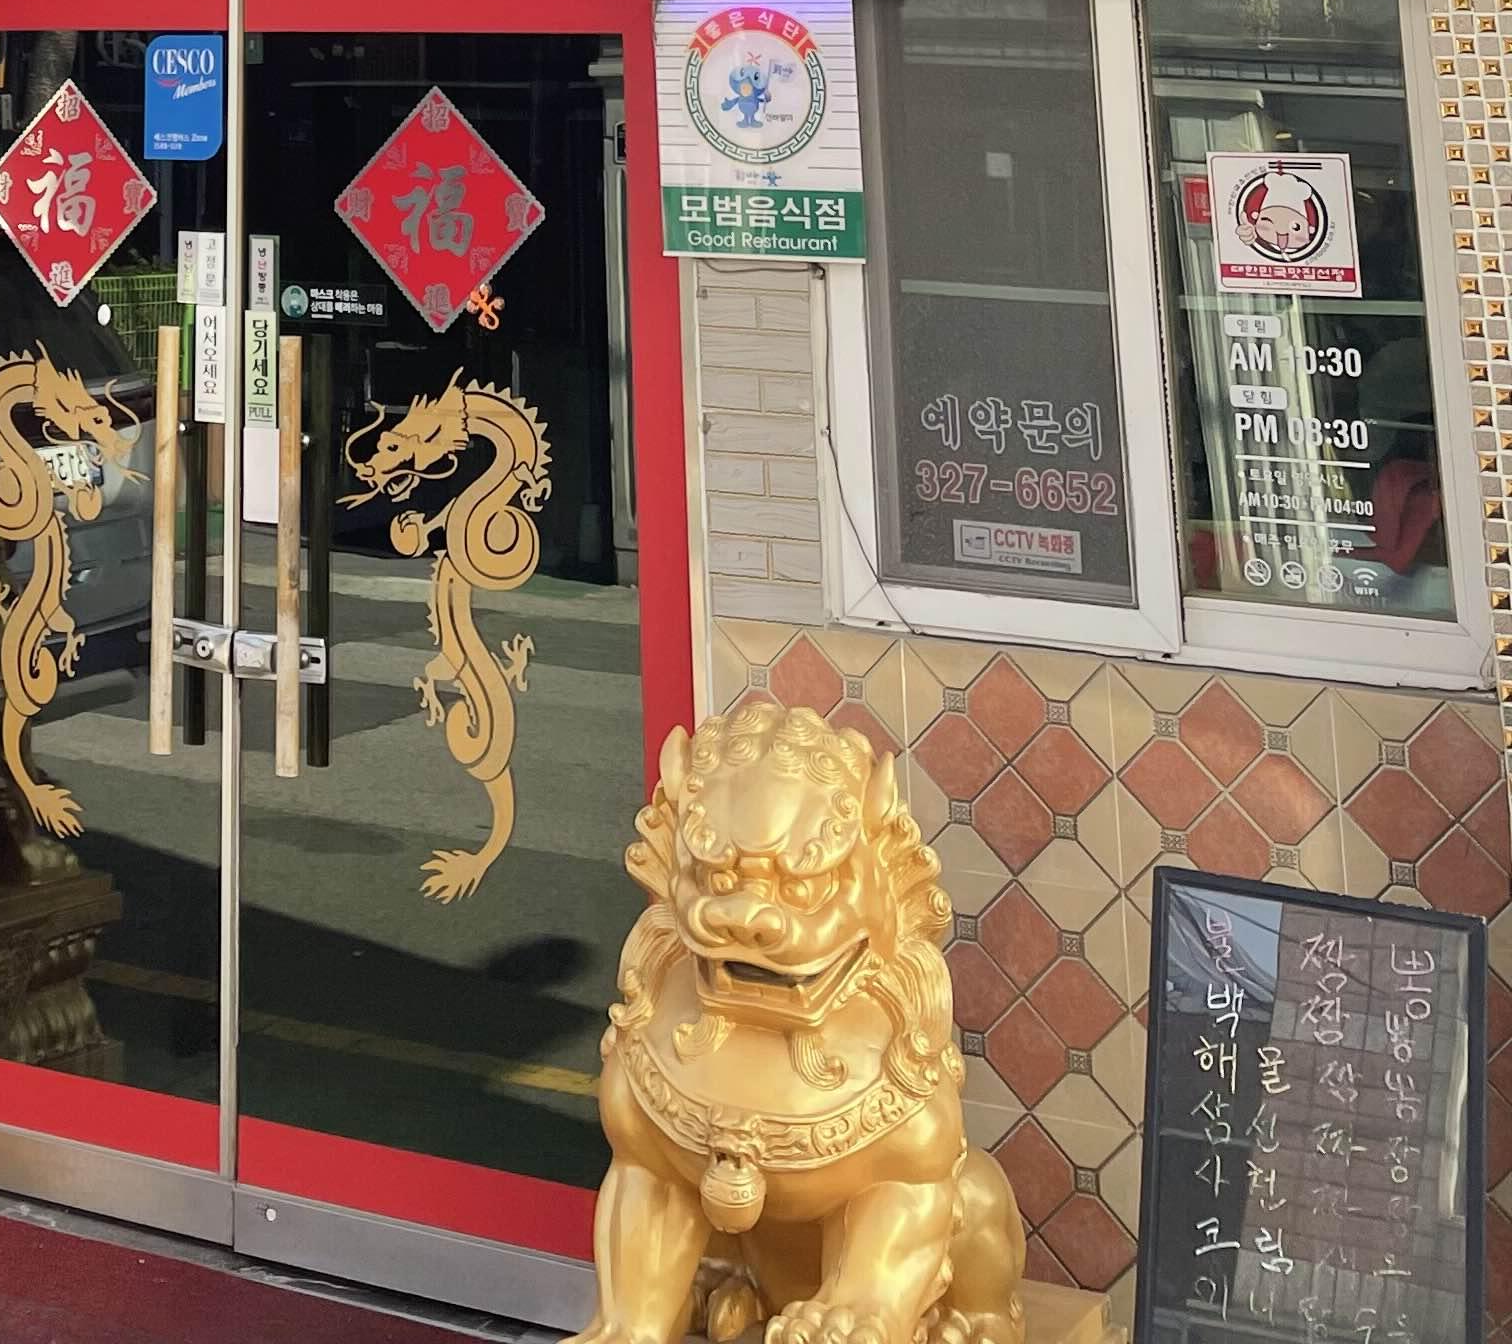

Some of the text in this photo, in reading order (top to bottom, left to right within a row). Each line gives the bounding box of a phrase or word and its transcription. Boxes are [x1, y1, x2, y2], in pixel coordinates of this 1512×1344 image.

[152, 48, 215, 75] CESCO
[27, 148, 96, 237] 福
[392, 161, 473, 256] 福
[678, 193, 847, 231] 모범음식점
[687, 230, 838, 252] Good Restaurant
[310, 288, 334, 300] 마스크
[366, 303, 383, 316] 마음
[203, 315, 217, 395] 어서오세요
[252, 319, 268, 395] 당기세요
[1229, 342, 1273, 372] AM
[249, 406, 272, 418] PULL
[1242, 389, 1272, 406] 닫힘
[921, 394, 1102, 460] 예약문의
[1234, 412, 1369, 450] PM 08:30
[915, 460, 1118, 515] 327-6652
[994, 528, 1074, 555] CCTV 녹화중
